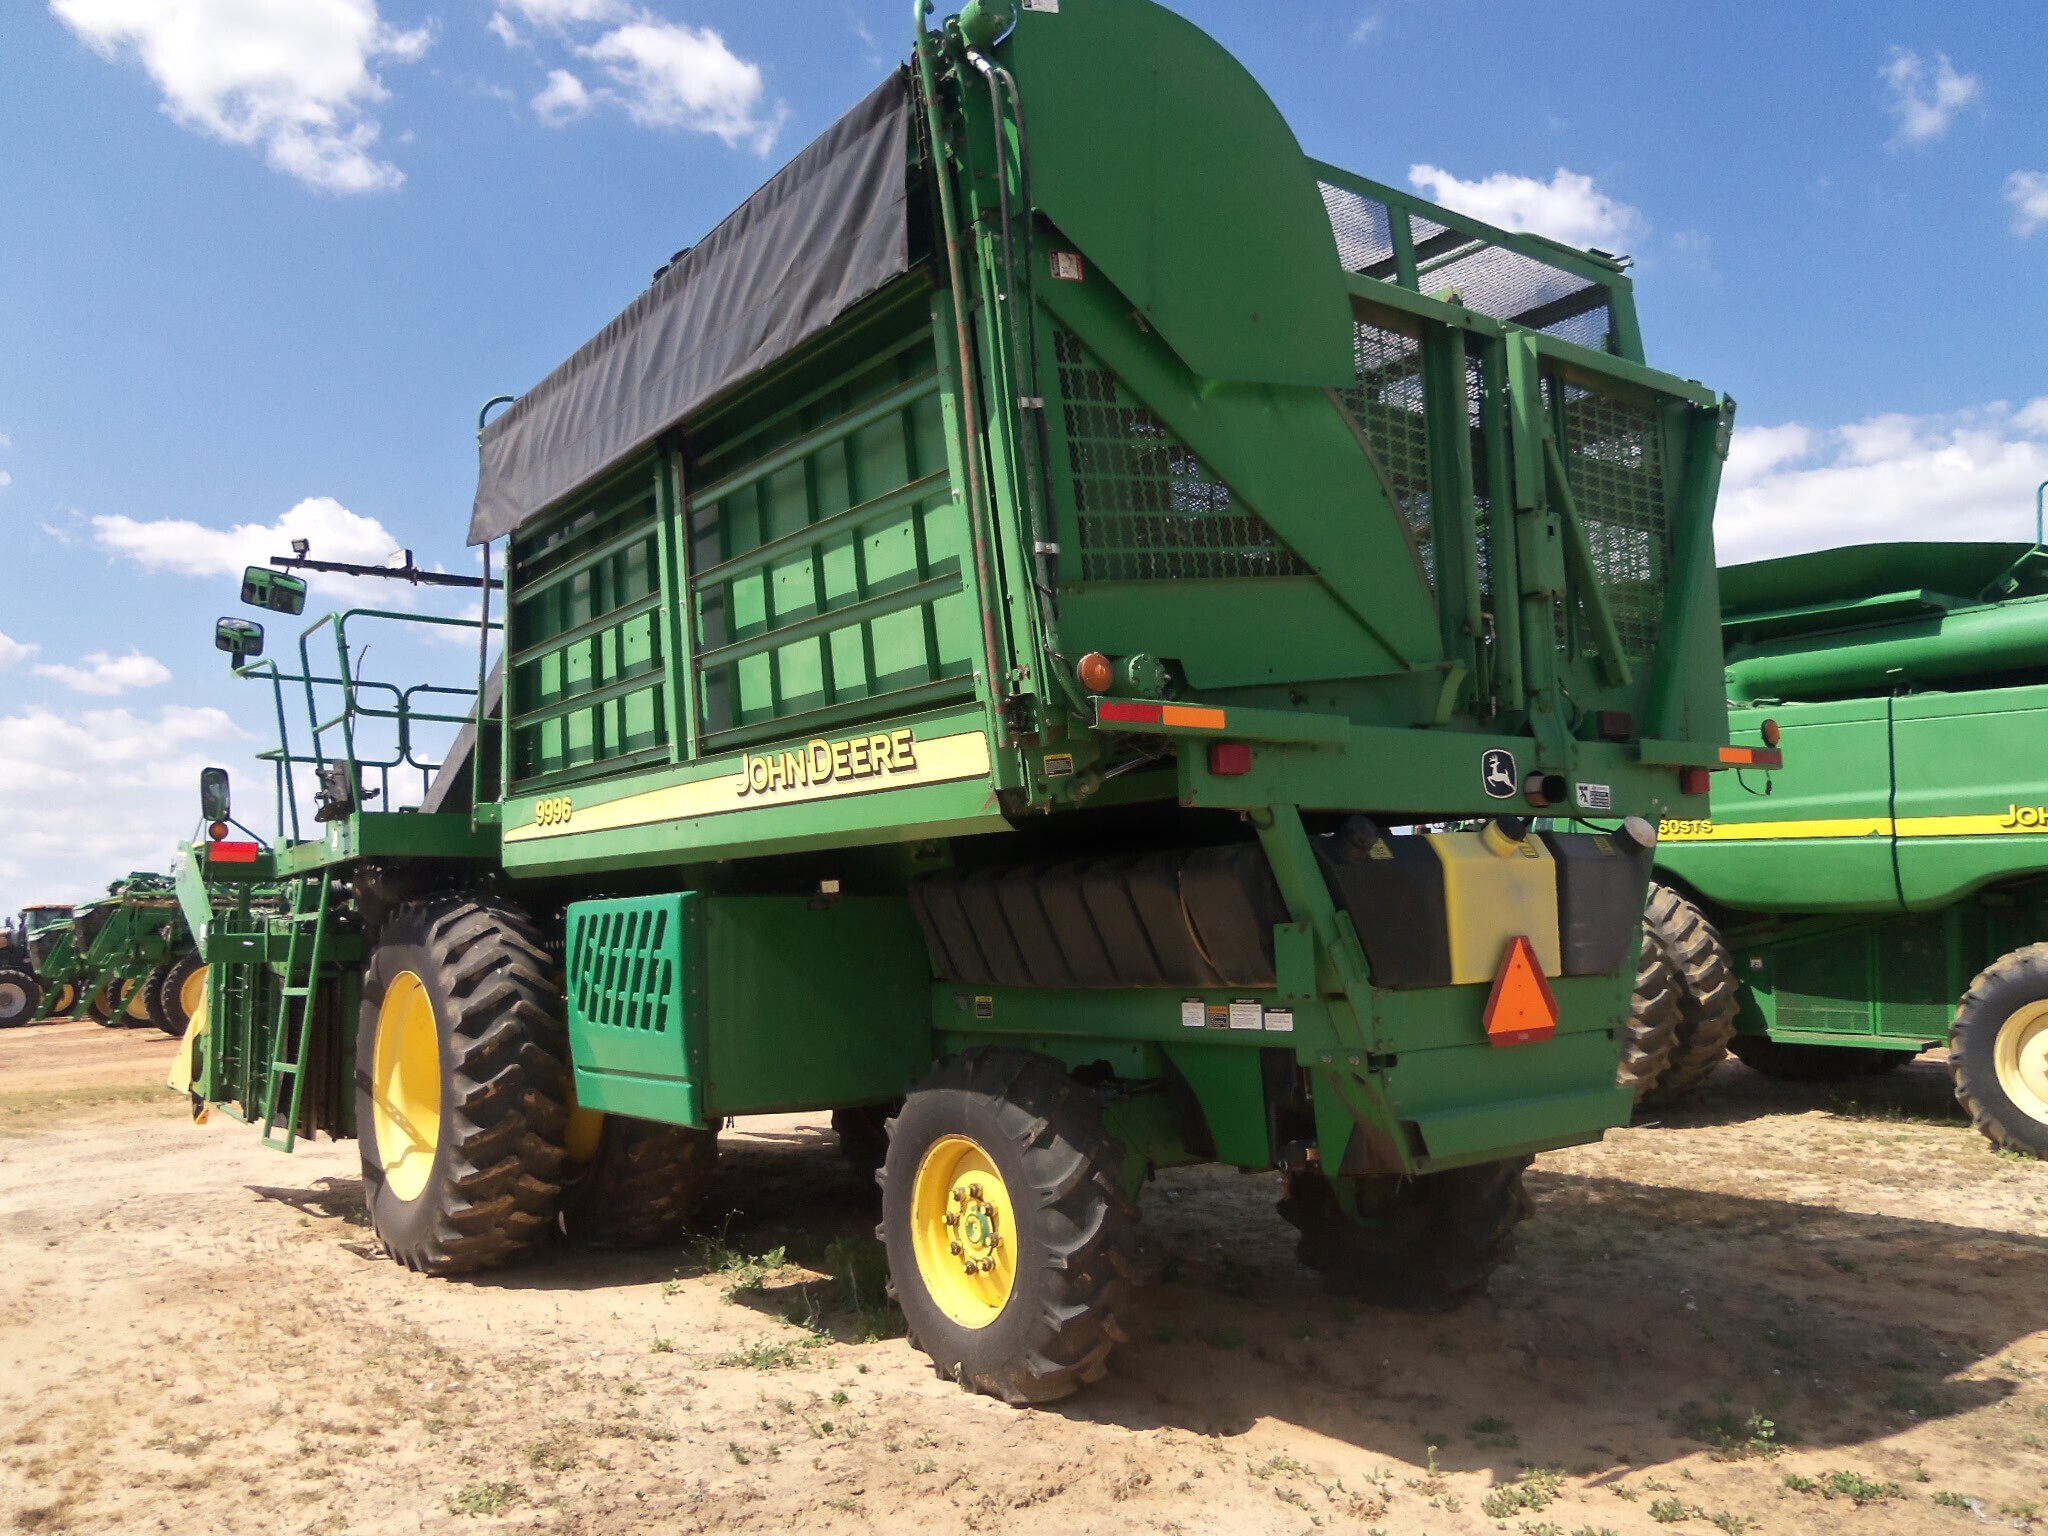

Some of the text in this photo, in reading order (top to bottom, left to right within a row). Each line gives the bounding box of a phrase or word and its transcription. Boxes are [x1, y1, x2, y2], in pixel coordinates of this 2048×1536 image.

[737, 728, 917, 797] JOHN DEERE
[536, 796, 573, 826] 9996
